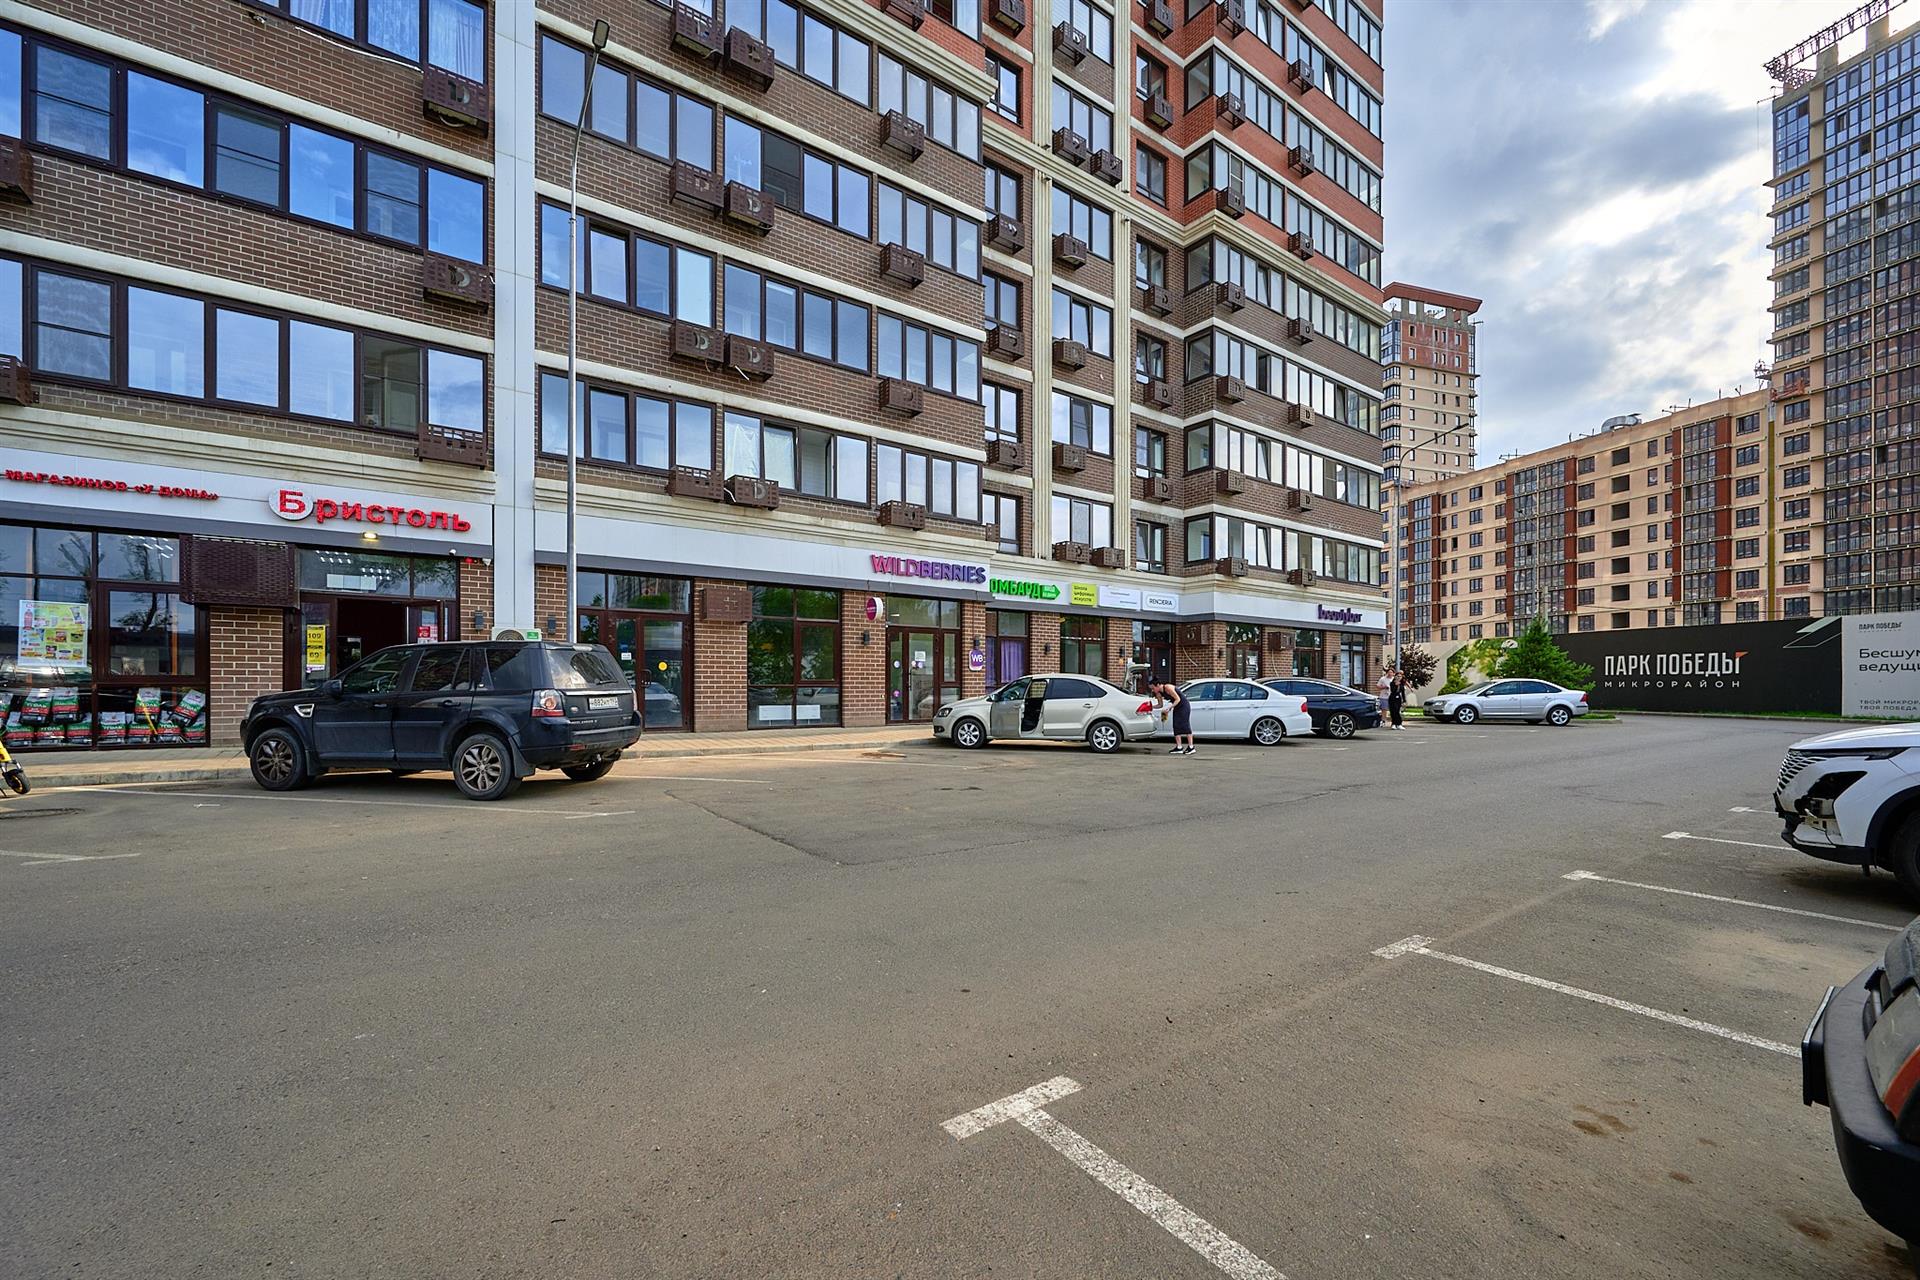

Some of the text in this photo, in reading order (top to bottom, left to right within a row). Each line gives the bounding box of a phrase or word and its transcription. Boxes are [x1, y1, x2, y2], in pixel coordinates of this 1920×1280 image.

[5, 469, 128, 491] МАГАЗИНОВ
[279, 489, 471, 532] Бристоль
[871, 554, 986, 584] WILDBERRIES
[989, 579, 1040, 600] ОМБАРД
[971, 654, 983, 663] WB
[1604, 651, 1748, 677] ПАРК ПОБЕДЫ
[1604, 680, 1740, 688] МИКРОРАЙОН
